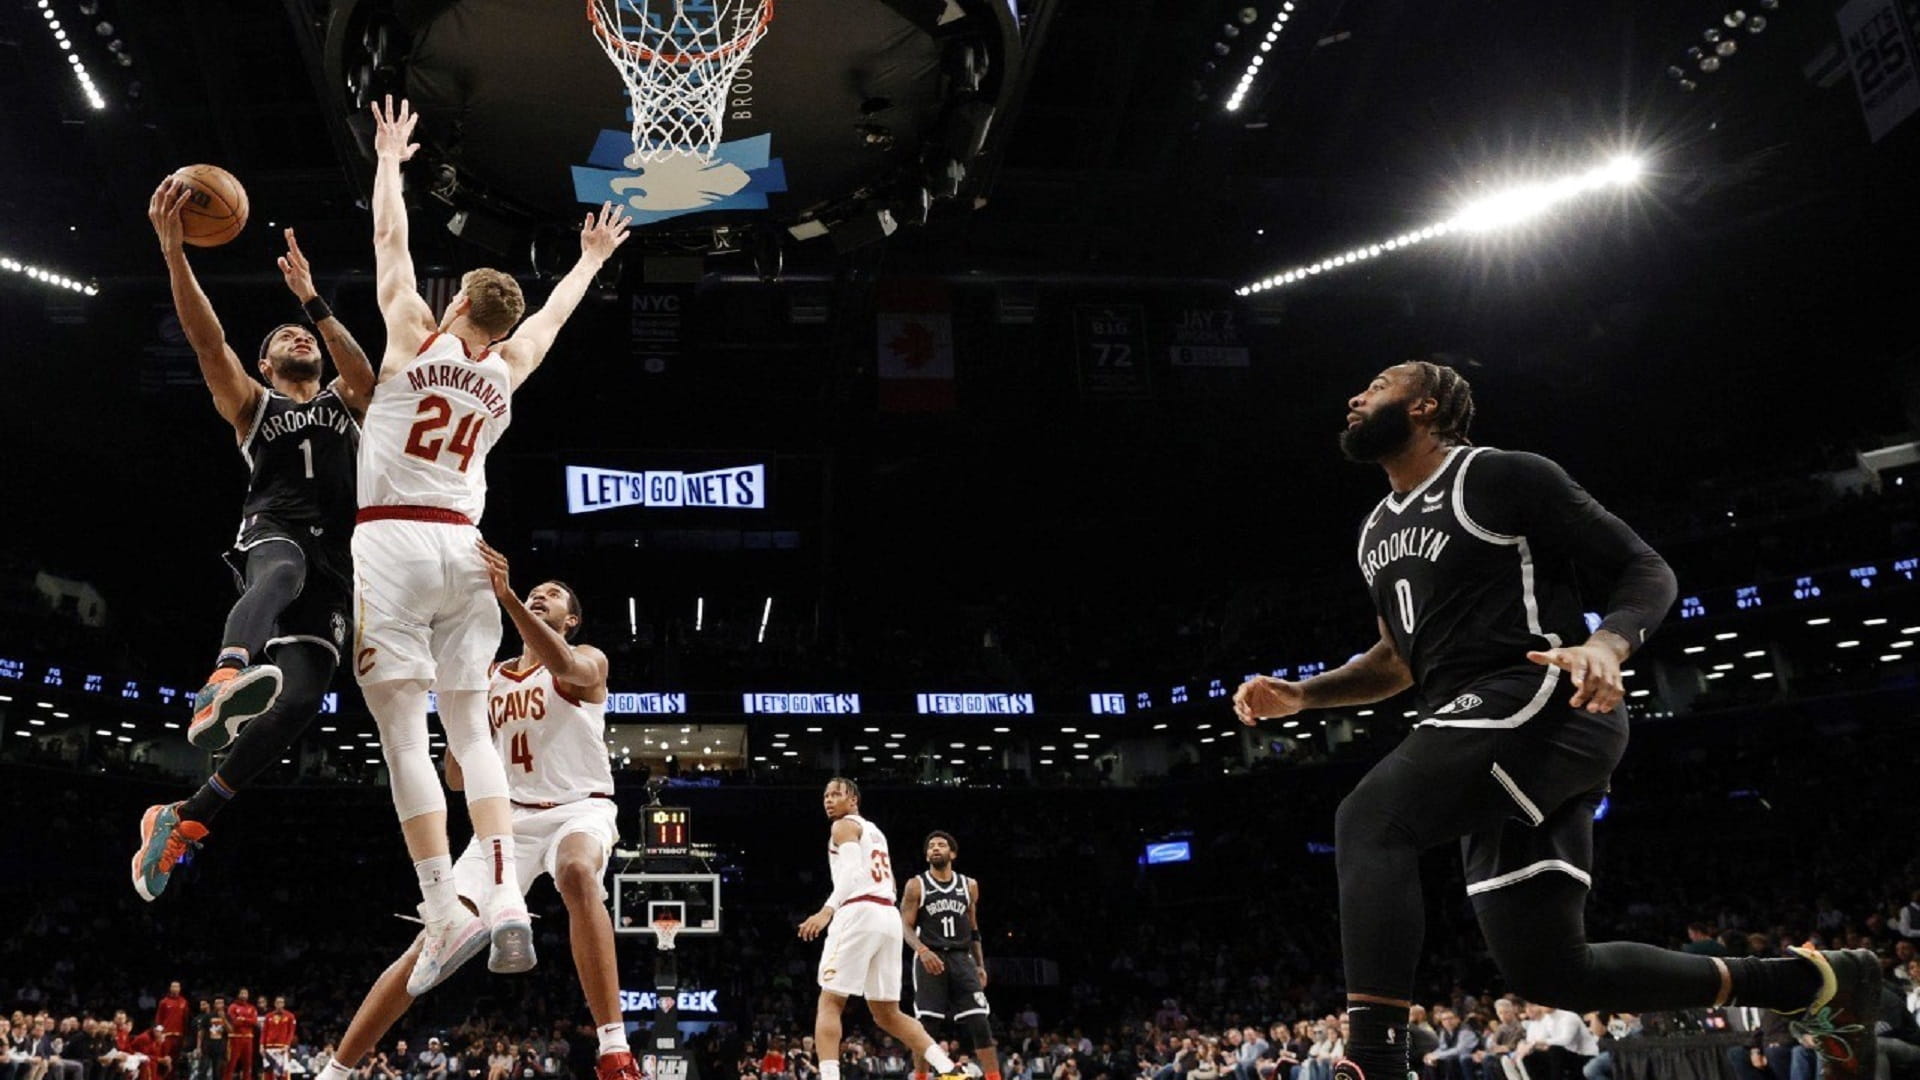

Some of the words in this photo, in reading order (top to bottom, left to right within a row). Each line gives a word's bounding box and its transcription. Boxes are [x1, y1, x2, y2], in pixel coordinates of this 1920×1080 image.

[1850, 6, 1898, 54] NETS
[1857, 41, 1905, 94] 25
[631, 295, 681, 313] NYC
[1091, 343, 1134, 368] 72
[407, 365, 508, 420] MARKKANEN
[260, 406, 350, 443] BROOKLYN
[404, 394, 485, 474] 24
[298, 439, 315, 479] 1
[581, 472, 641, 507] LET'S
[651, 475, 677, 502] GO
[686, 470, 755, 506] NETS
[1361, 526, 1450, 587] BROOKLYN
[1395, 578, 1414, 634] 0
[490, 687, 545, 729] CAVS
[619, 695, 634, 711] GO
[640, 694, 679, 713] NETS
[753, 694, 788, 713] LET'S
[793, 695, 808, 712] GO
[814, 694, 854, 713] NETS
[927, 694, 962, 713] LET'S
[966, 695, 982, 712] GO
[987, 694, 1027, 713] NETS
[511, 731, 533, 773] 4
[662, 825, 682, 844] 11
[871, 849, 889, 883] 35
[926, 899, 967, 917] BROOKLYN
[941, 915, 956, 938] 11
[620, 989, 719, 1013] SEATEEK
